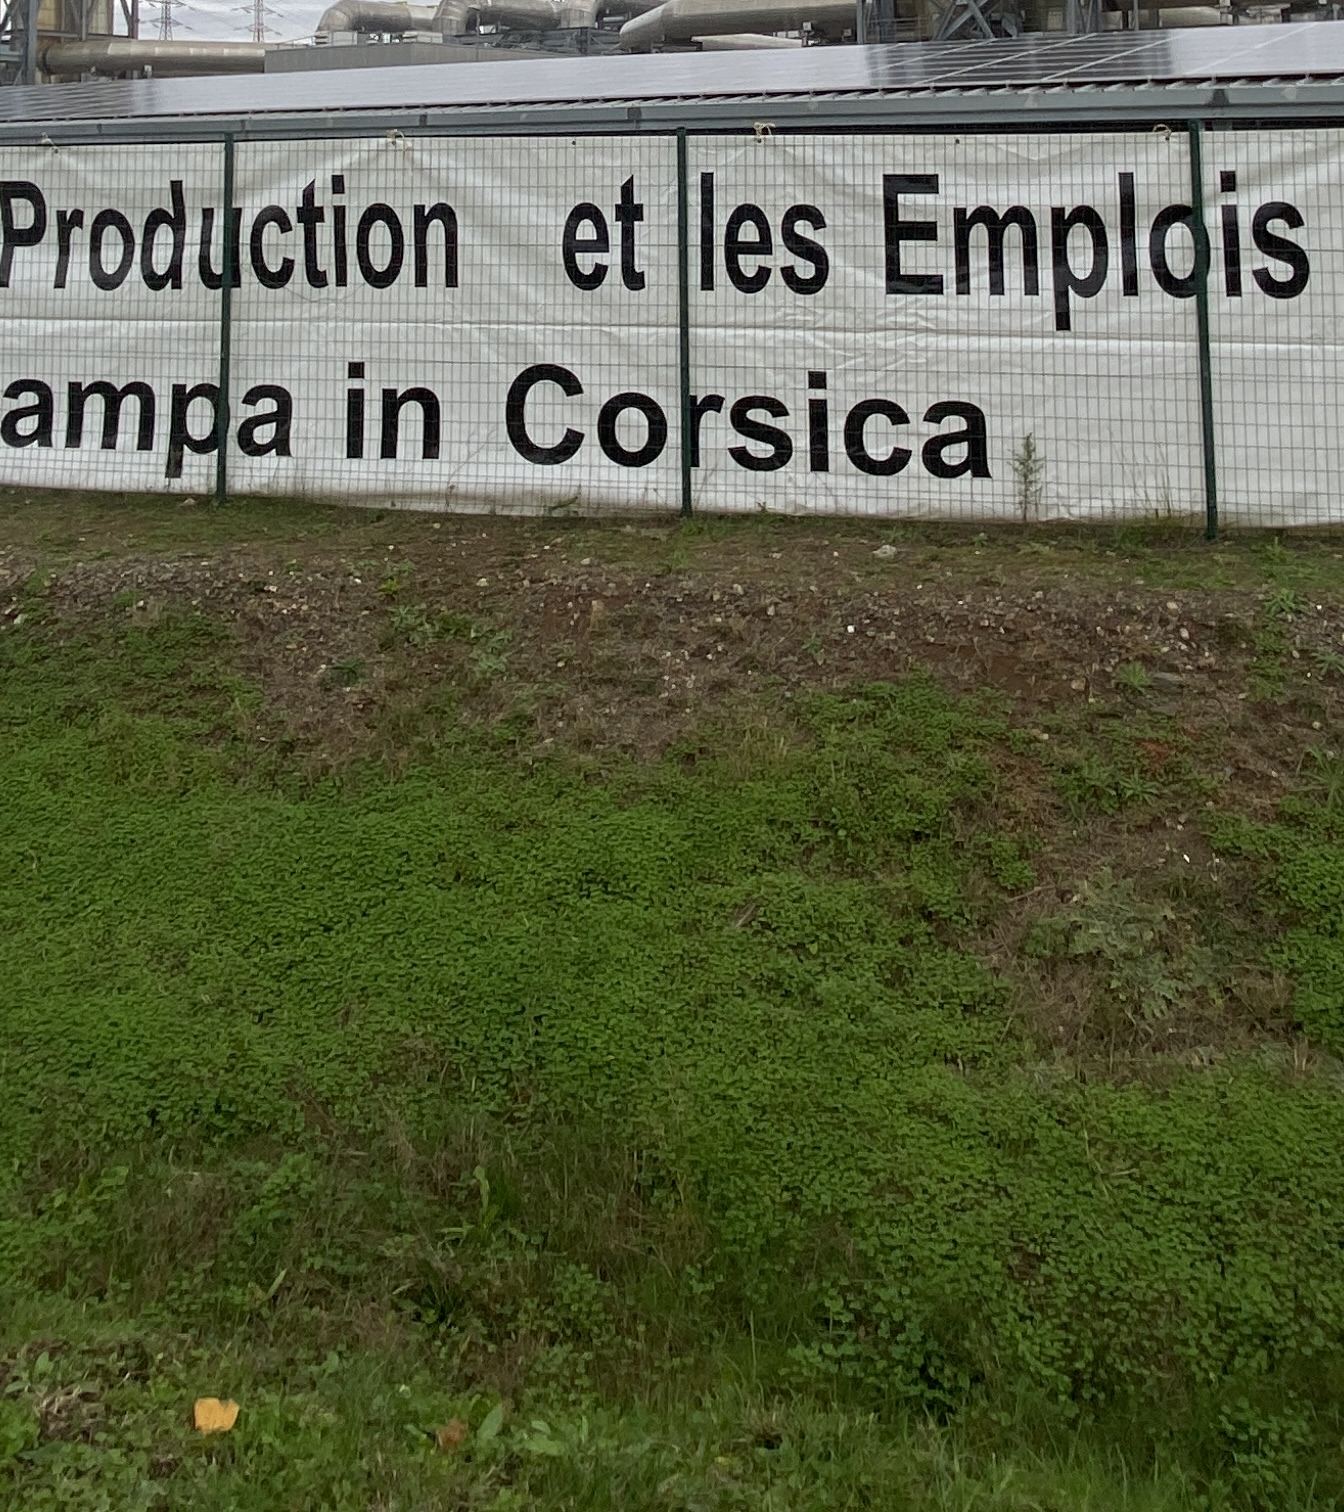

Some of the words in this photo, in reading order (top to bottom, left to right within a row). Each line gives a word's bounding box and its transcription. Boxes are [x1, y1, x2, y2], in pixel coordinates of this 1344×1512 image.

[562, 174, 646, 292] et
[699, 171, 831, 296] les
[881, 170, 1310, 332] Emplois
[346, 361, 441, 460] in
[505, 363, 992, 479] Corsica
